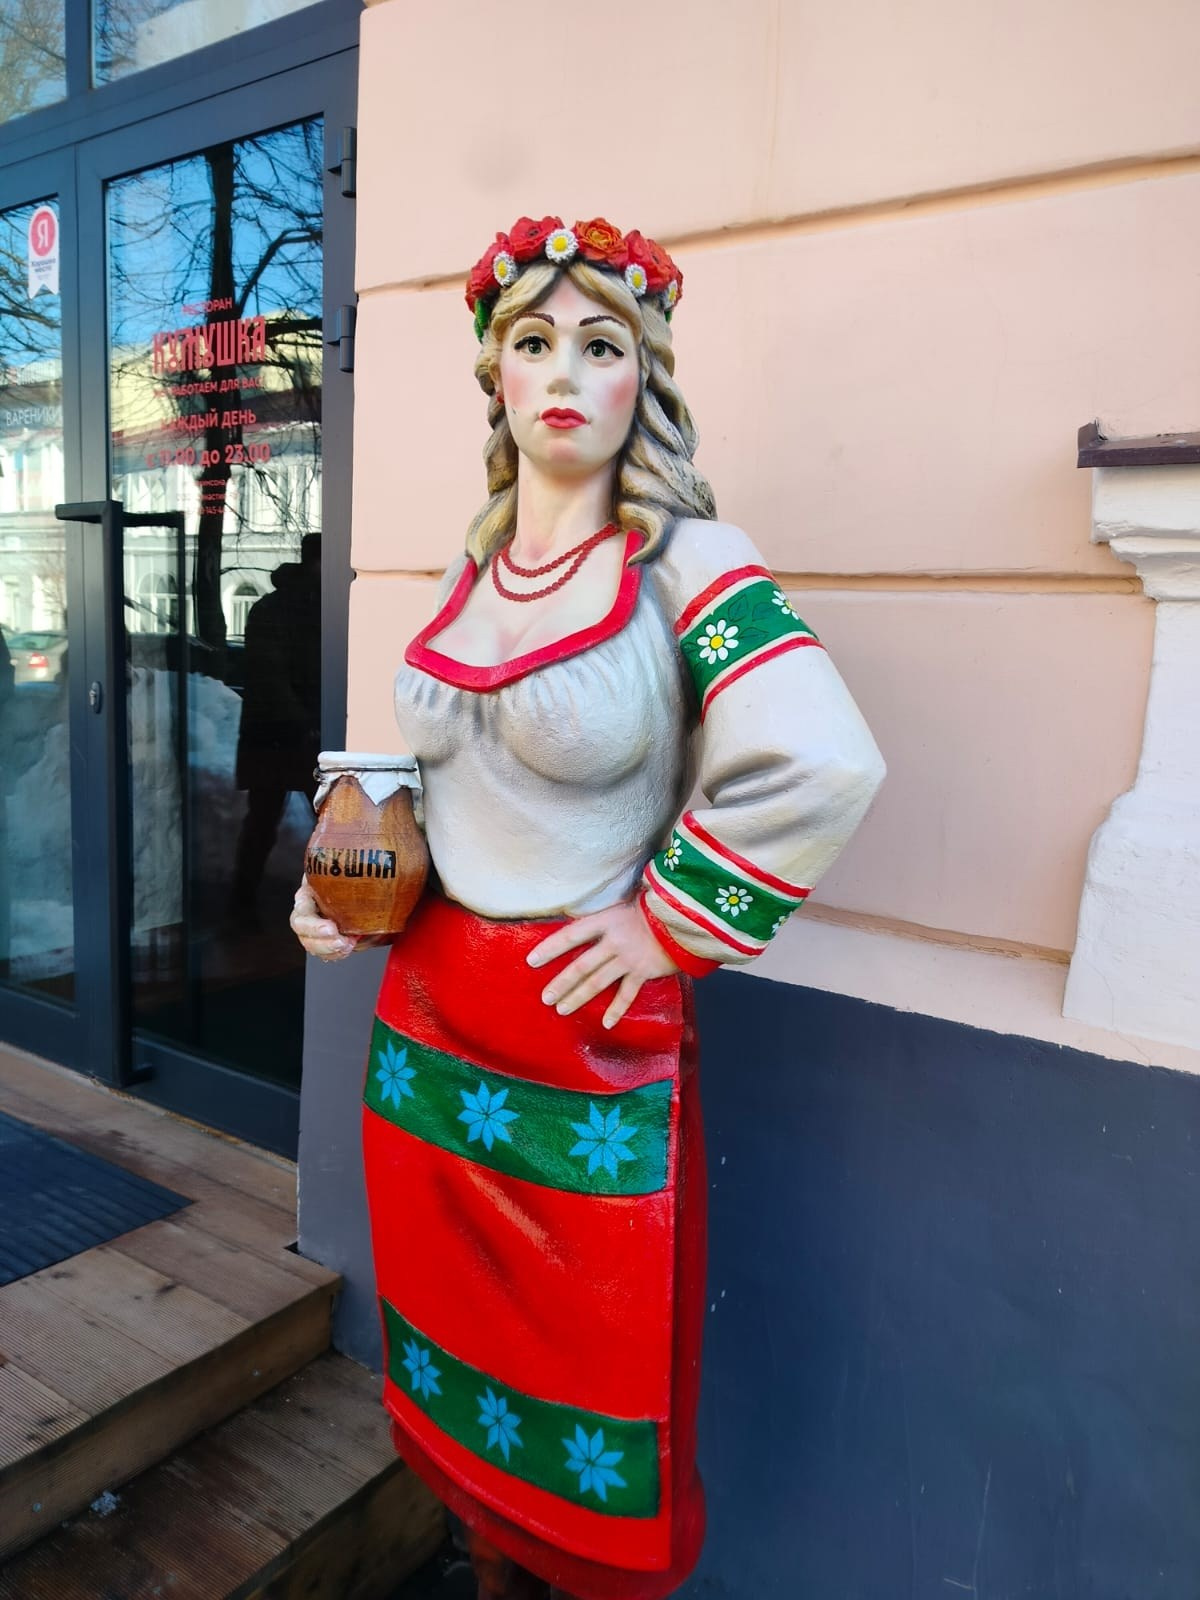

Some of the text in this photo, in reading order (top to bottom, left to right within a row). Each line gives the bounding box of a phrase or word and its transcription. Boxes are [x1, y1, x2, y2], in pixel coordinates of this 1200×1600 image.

[37, 219, 49, 249] Я
[153, 315, 266, 375] КУМУШКА
[219, 378, 240, 393] ДЛЯ
[6, 406, 63, 426] ВАРЕНИКИ
[221, 409, 257, 429] ДЕНЬ
[200, 449, 220, 468] до
[224, 442, 271, 465] 23.00
[306, 847, 396, 879] УМУШКА
